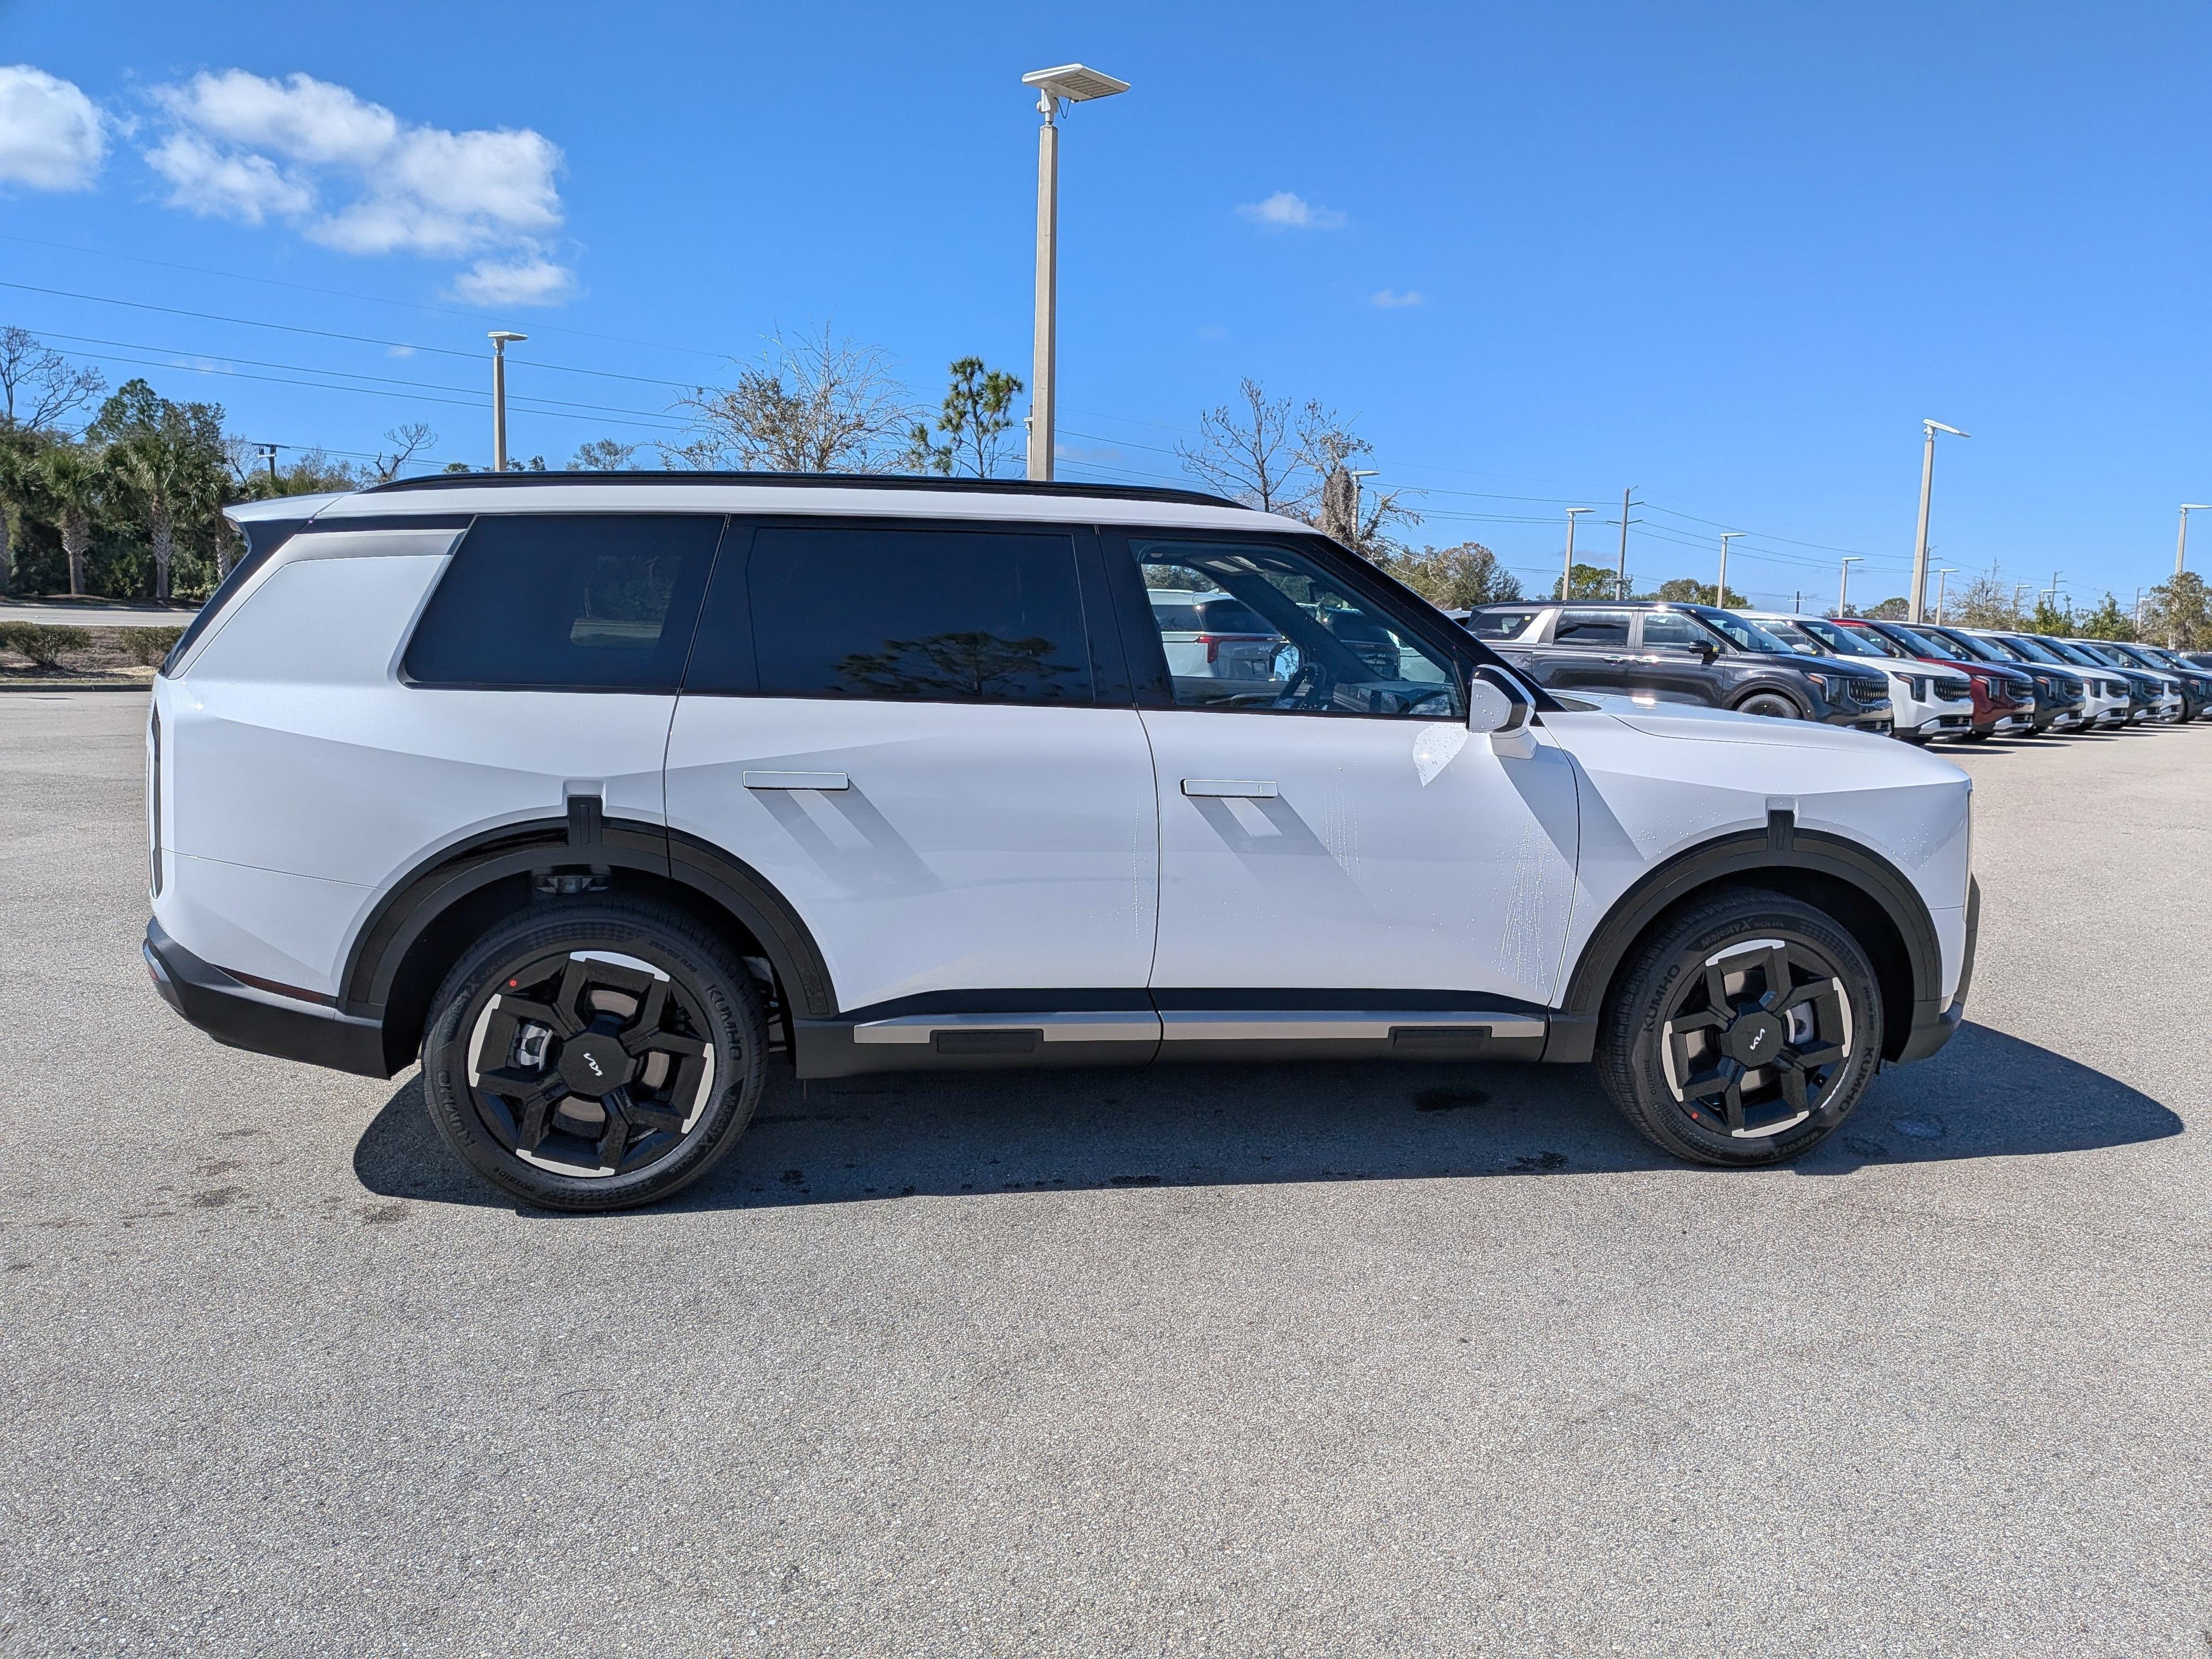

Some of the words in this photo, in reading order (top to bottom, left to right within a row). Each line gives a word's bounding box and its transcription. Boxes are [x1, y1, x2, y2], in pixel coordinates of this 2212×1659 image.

[704, 983, 743, 1061] KUMHO
[1643, 964, 1681, 1032] KUMHO
[583, 1052, 603, 1076] KIA
[1750, 1028, 1765, 1050] KIA
[437, 1069, 478, 1149] KUMHO
[1643, 1058, 1657, 1096] OUTSIDE
[1838, 1046, 1874, 1113] KUMHO
